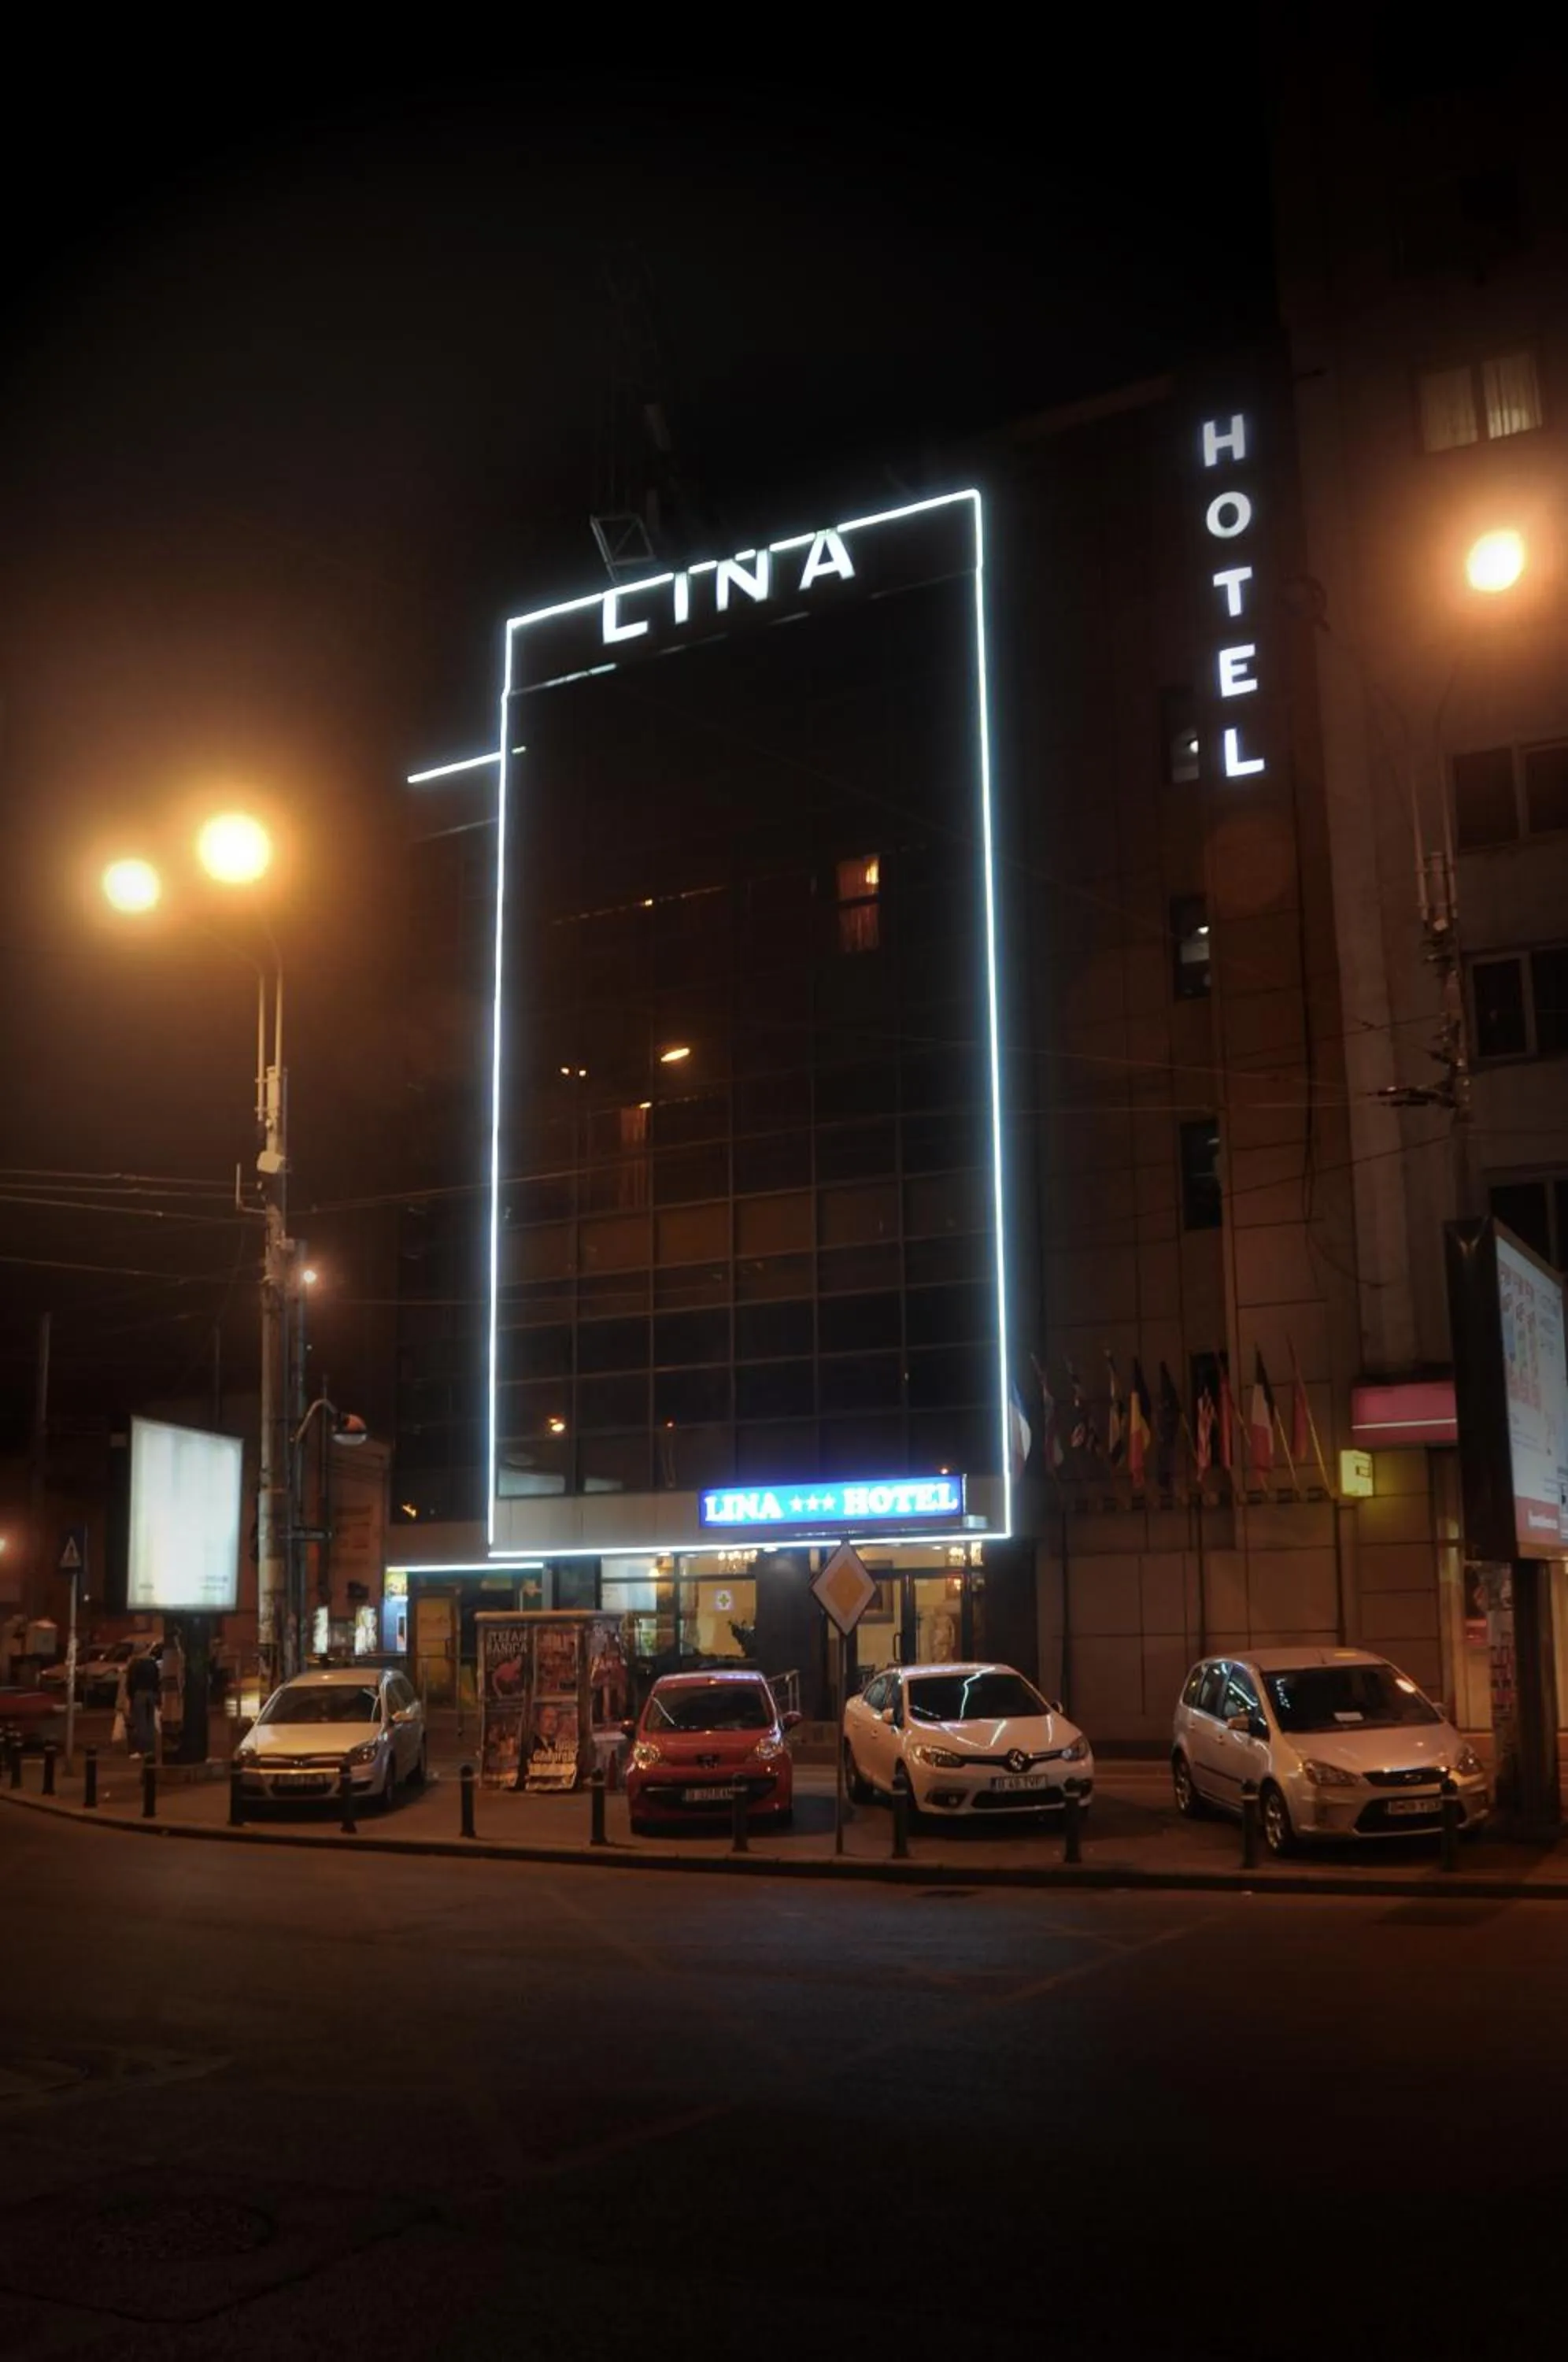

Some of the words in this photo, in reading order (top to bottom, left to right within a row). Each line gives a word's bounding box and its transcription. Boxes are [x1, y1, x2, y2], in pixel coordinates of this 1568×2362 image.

[602, 528, 856, 644] LINA
[1203, 414, 1265, 777] HOTEL
[704, 1491, 783, 1522] LINA
[842, 1483, 958, 1516] HOTEL
